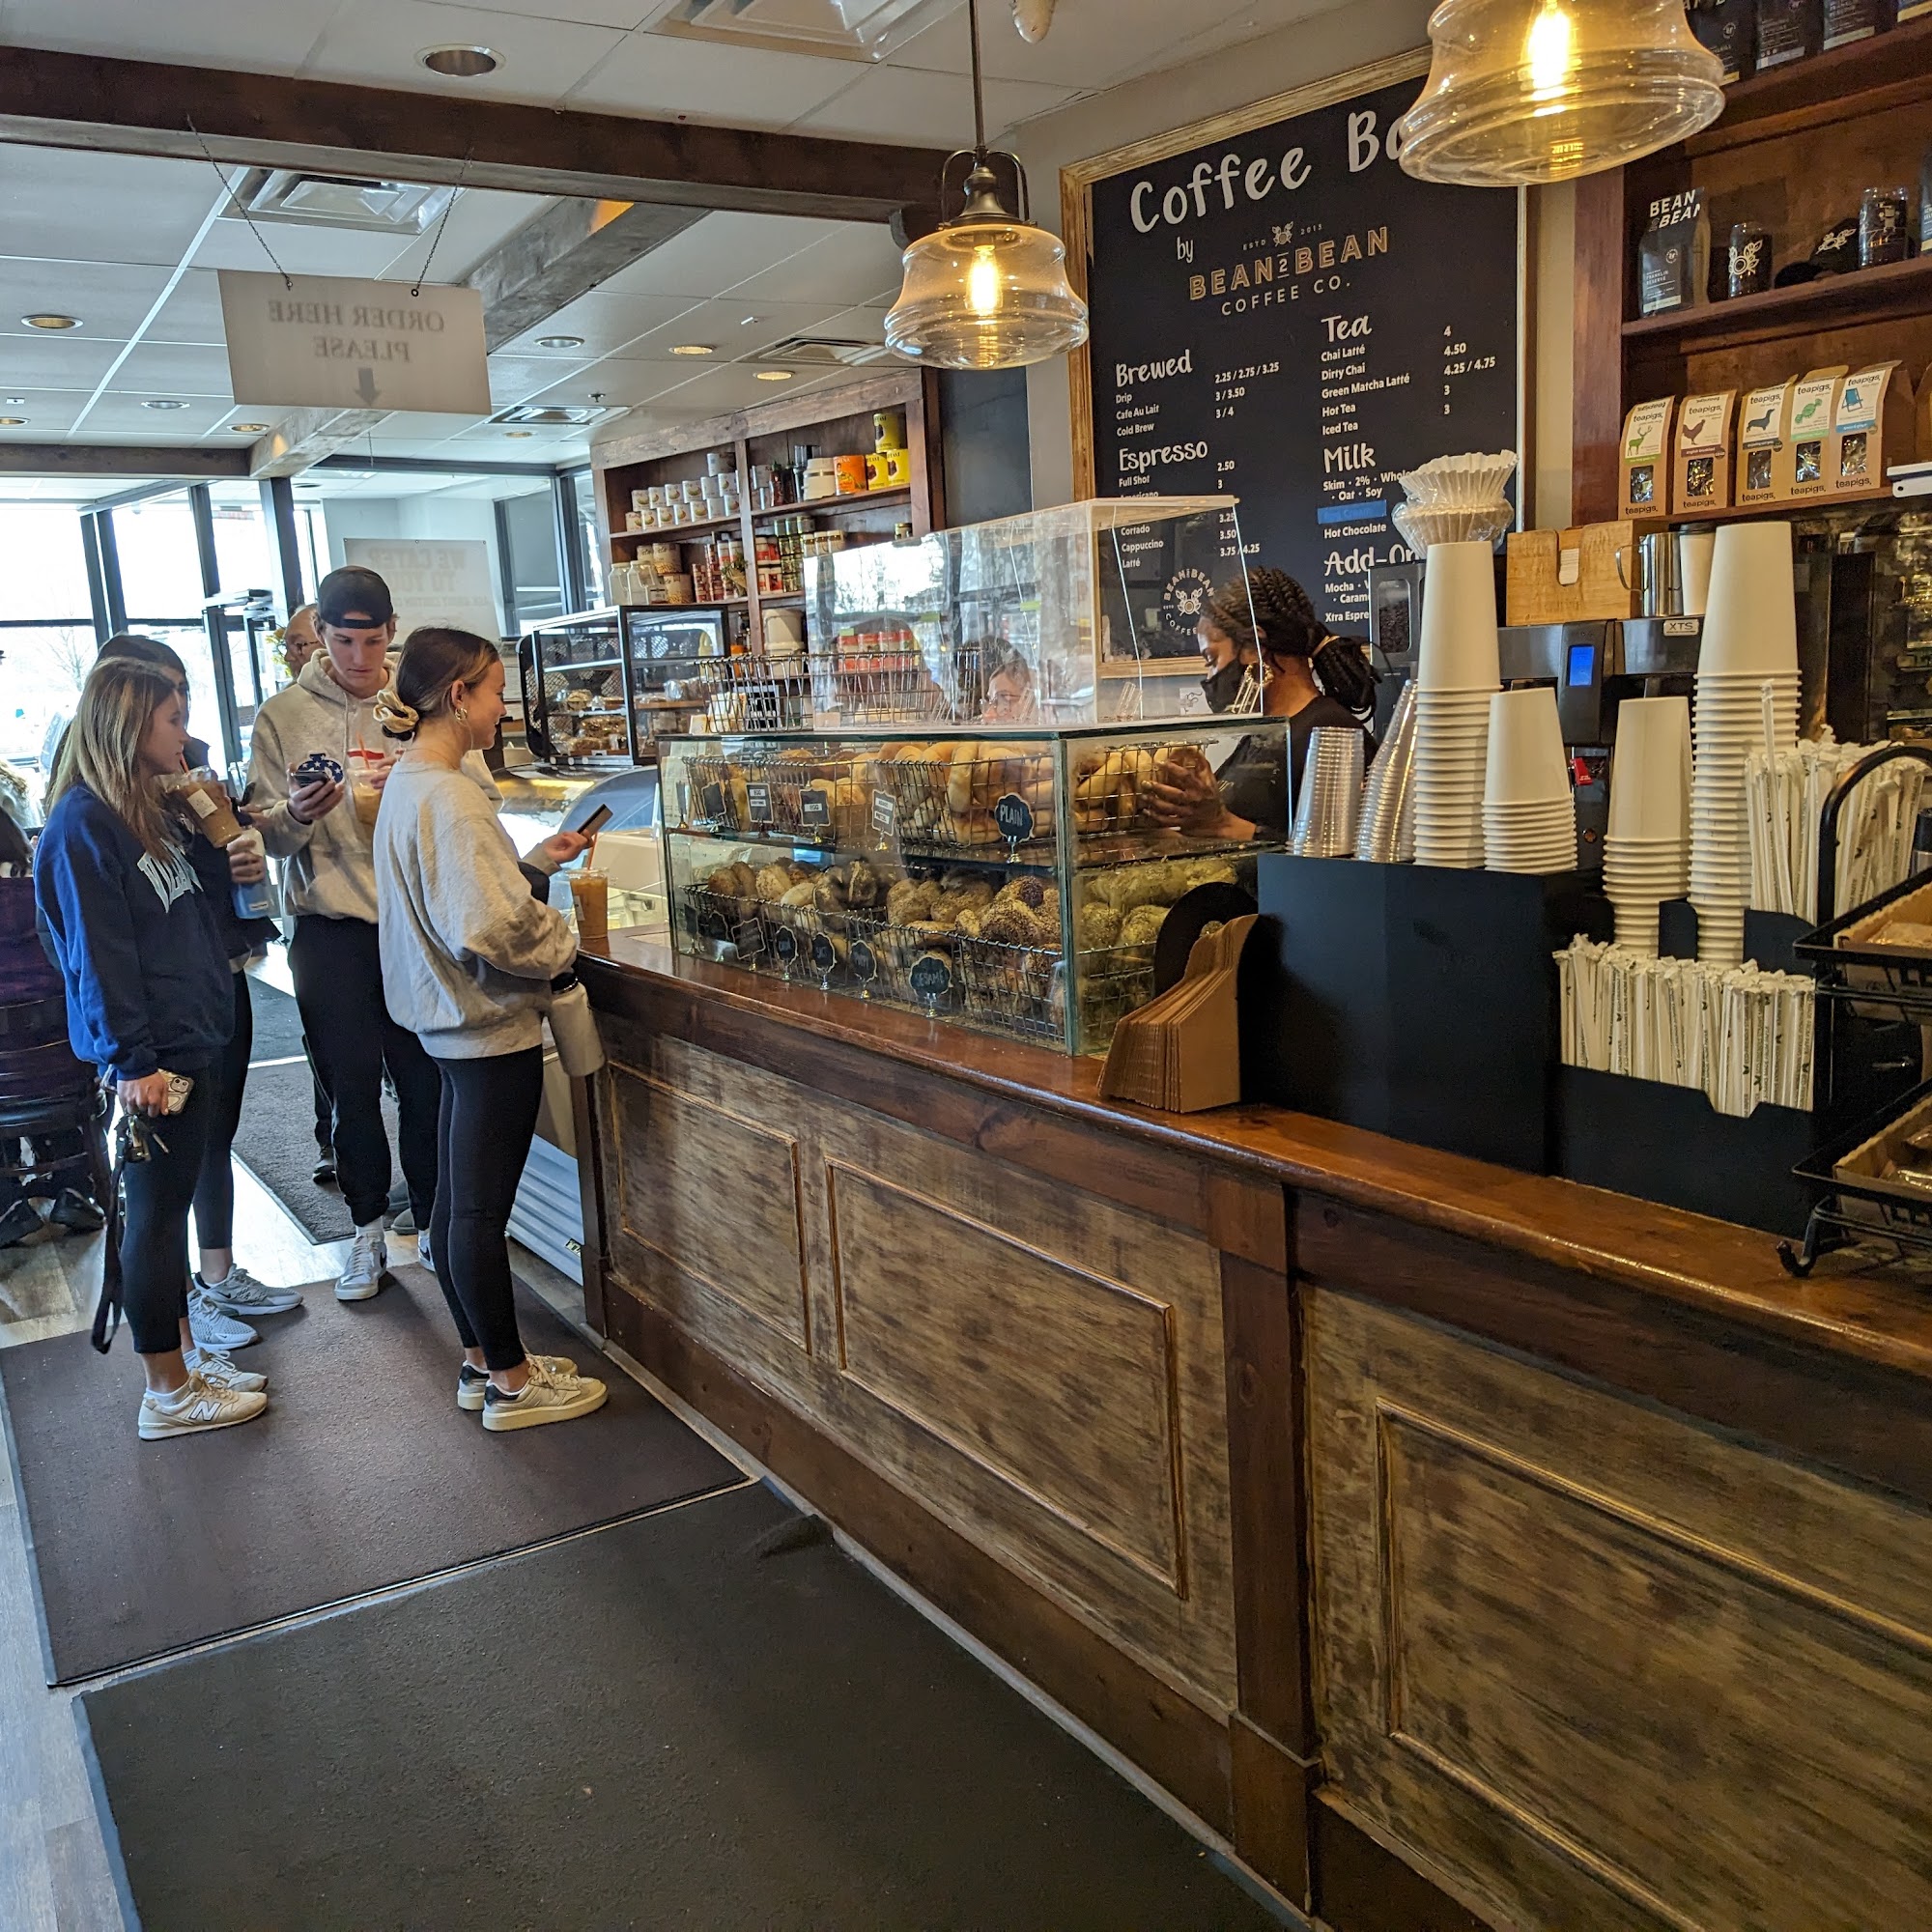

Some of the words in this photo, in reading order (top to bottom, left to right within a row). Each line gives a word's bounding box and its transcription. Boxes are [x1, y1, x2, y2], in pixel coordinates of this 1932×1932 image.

[1130, 147, 1312, 234] Coffee
[1649, 189, 1696, 217] BEAN
[1176, 237, 1194, 263] by
[1189, 256, 1273, 300] BEAN
[1294, 226, 1388, 274] BEAN
[1221, 285, 1299, 316] COFFEE
[1314, 275, 1350, 294] CO.
[1321, 315, 1373, 343] Tea
[1444, 326, 1451, 337] 4
[1321, 350, 1341, 362] Chai
[1444, 342, 1466, 356] 4.50
[1116, 349, 1193, 387] Brewed
[1215, 371, 1232, 384] 2.25
[1238, 366, 1256, 380] 2.75
[1262, 361, 1280, 375] 3.25
[1321, 367, 1344, 382] Dirty
[1346, 362, 1366, 376] Chai
[1444, 362, 1465, 376] 4.25
[1473, 355, 1496, 371] 4.75
[1215, 391, 1221, 401] 3
[1227, 386, 1245, 399] 3.50
[1321, 386, 1350, 400] Green
[1351, 380, 1384, 394] Matcha
[1444, 384, 1450, 396] 3
[1116, 392, 1133, 405] Drip
[1116, 407, 1133, 420] Cafe
[1134, 407, 1145, 417] Au
[1146, 404, 1159, 415] Lait
[1215, 409, 1221, 418] 3
[1228, 407, 1235, 416] 4
[1322, 405, 1340, 417] Hot
[1340, 403, 1356, 414] Tea
[1444, 404, 1450, 415] 3
[1117, 425, 1134, 437] Cold
[1135, 422, 1154, 434] Brew
[1322, 423, 1341, 436] Iced
[1343, 421, 1358, 432] Tea
[1119, 440, 1208, 473] Espresso
[1323, 442, 1377, 473] Milk
[1217, 460, 1236, 472] 2.50
[1119, 476, 1132, 488] Full
[1133, 474, 1151, 485] Shot
[1217, 479, 1223, 490] 3
[1322, 479, 1345, 492] Skim
[1355, 475, 1371, 488] 2%
[1338, 491, 1355, 501] Oat
[1365, 487, 1383, 498] Soy
[1219, 513, 1236, 524] 3.25
[1121, 525, 1151, 536] Cortado
[1219, 528, 1237, 540] 3.50
[1323, 528, 1341, 539] Hot
[1342, 523, 1387, 537] Chocolate
[1122, 539, 1164, 554] Cappuccino
[1220, 546, 1236, 557] 3.75
[1243, 543, 1261, 554] 4.25
[1323, 543, 1420, 577] Add-On
[1324, 582, 1354, 594] Mocha
[1339, 592, 1370, 604] Caram
[1324, 612, 1344, 622] Xtra
[1345, 610, 1370, 622] Espre
[1165, 612, 1197, 637] COFFEE
[1669, 622, 1693, 631] XTS
[1000, 804, 1023, 827] PLAIN
